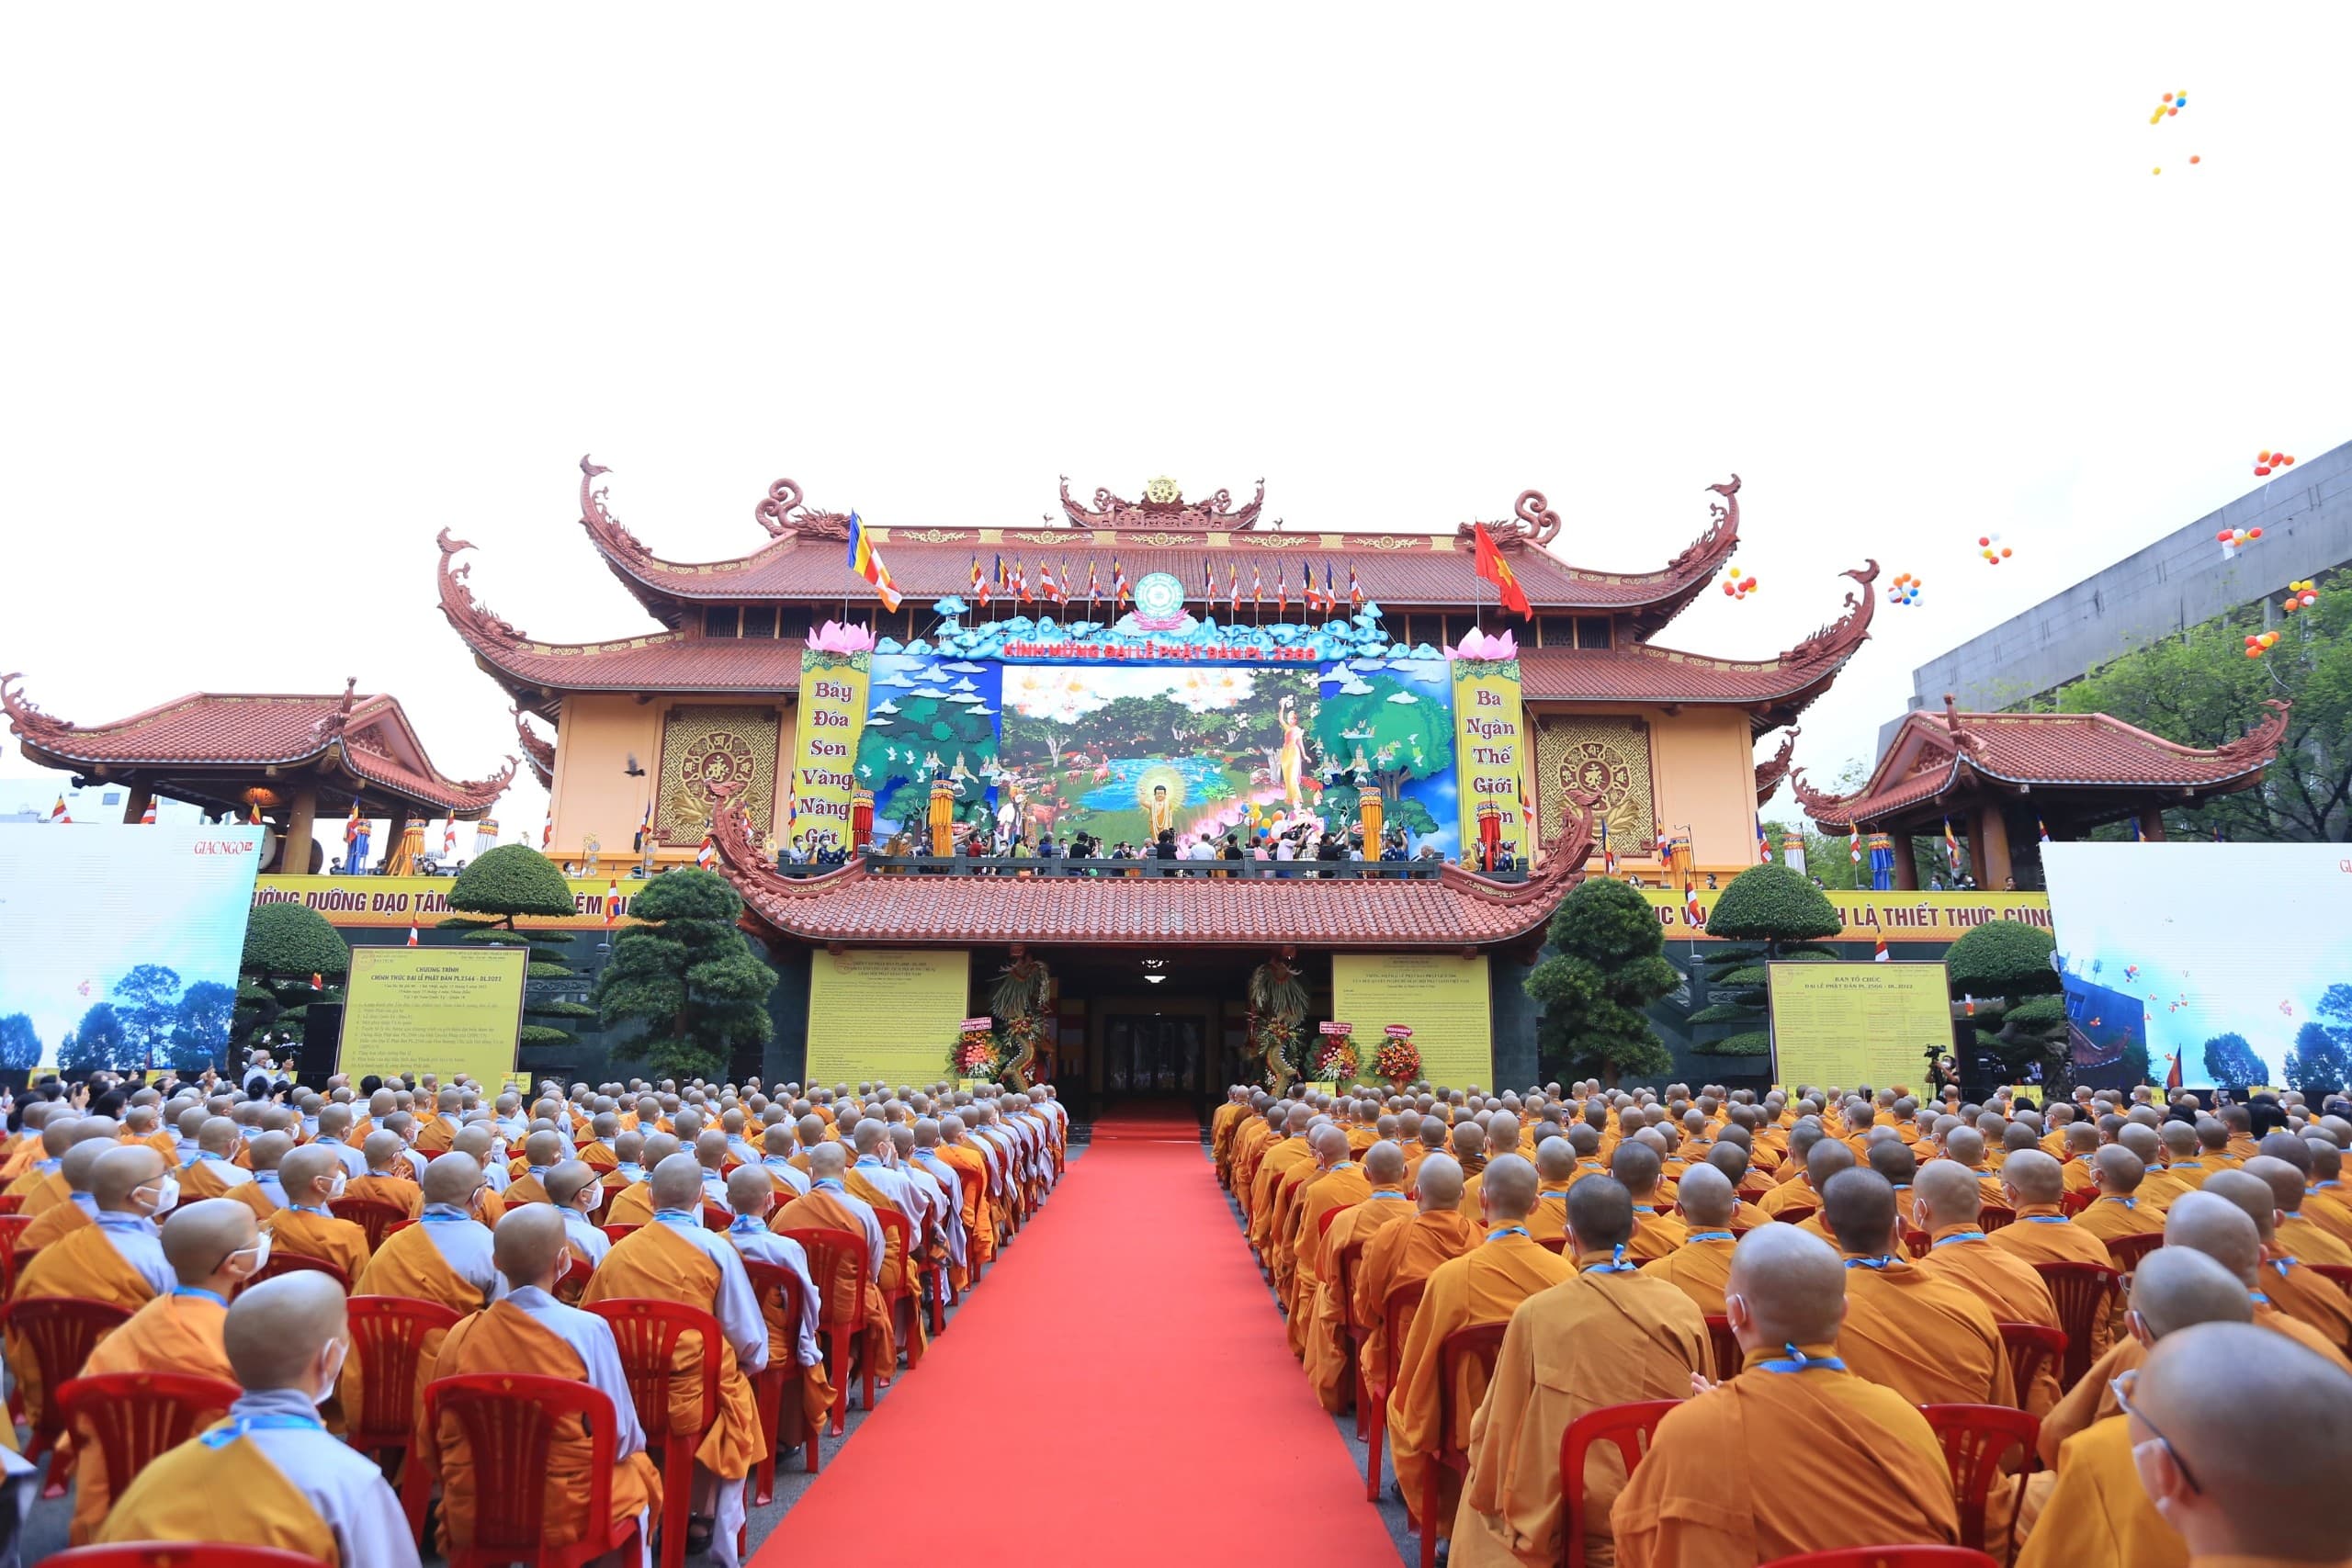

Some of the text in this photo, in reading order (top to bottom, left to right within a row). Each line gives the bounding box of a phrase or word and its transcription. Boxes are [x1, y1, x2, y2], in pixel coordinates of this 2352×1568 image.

[1272, 647, 1316, 660] 2566
[815, 682, 853, 703] Bảy
[1476, 690, 1501, 705] Ba
[813, 711, 849, 727] Đóa
[1466, 718, 1515, 739] Ngàn
[810, 739, 846, 756] Sen
[1473, 746, 1512, 764] Thế
[802, 769, 854, 791] Vàng
[1473, 777, 1512, 794] Giới
[799, 798, 851, 821] Nâng
[306, 888, 367, 912] DƯỠNG
[372, 894, 409, 917] ĐẠO
[1853, 904, 1879, 926] LÀ
[1883, 902, 1939, 926] THIẾT
